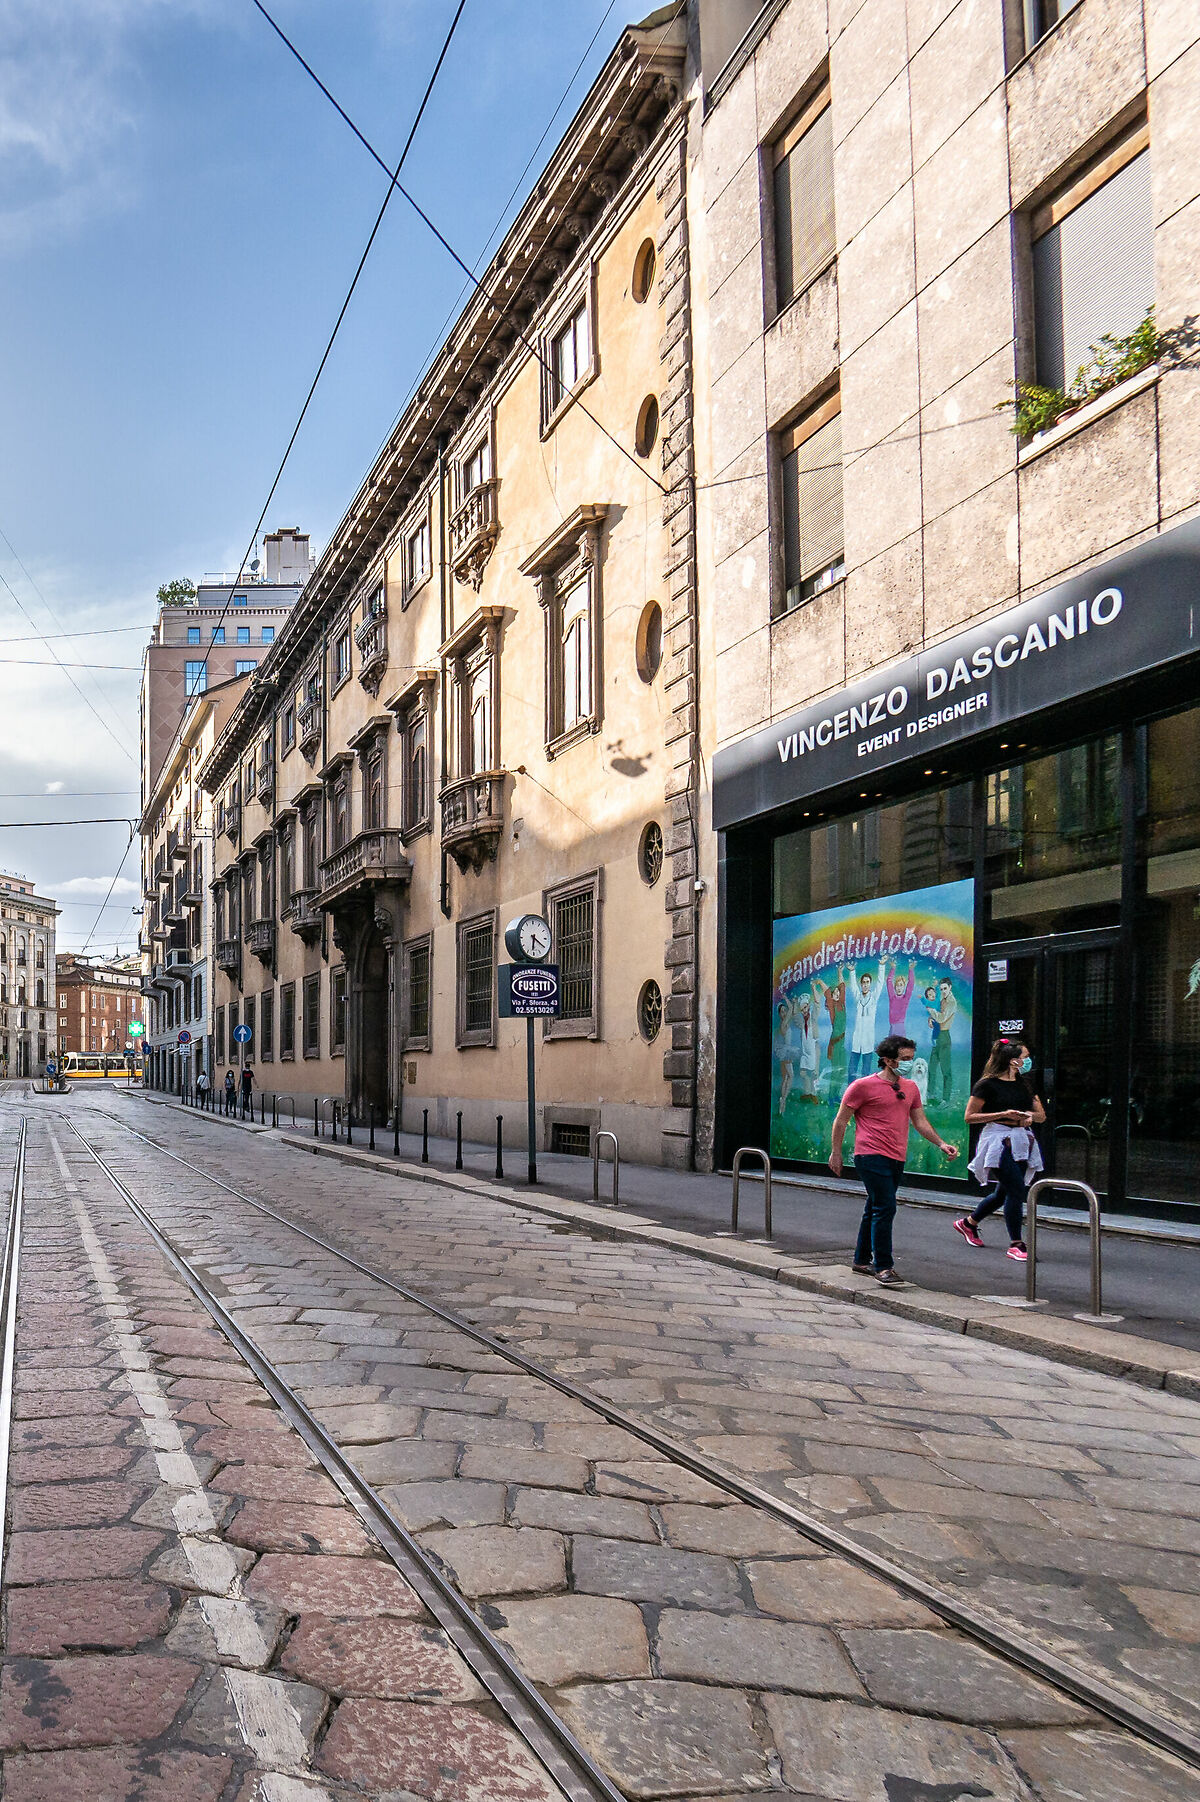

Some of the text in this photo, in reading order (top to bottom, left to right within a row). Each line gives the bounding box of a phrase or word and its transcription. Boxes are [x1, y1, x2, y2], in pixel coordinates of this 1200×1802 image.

[777, 587, 1124, 763] VINCENZO DASCANIO
[857, 692, 989, 757] EVENT DESIGNER
[518, 980, 551, 991] FUSETTI
